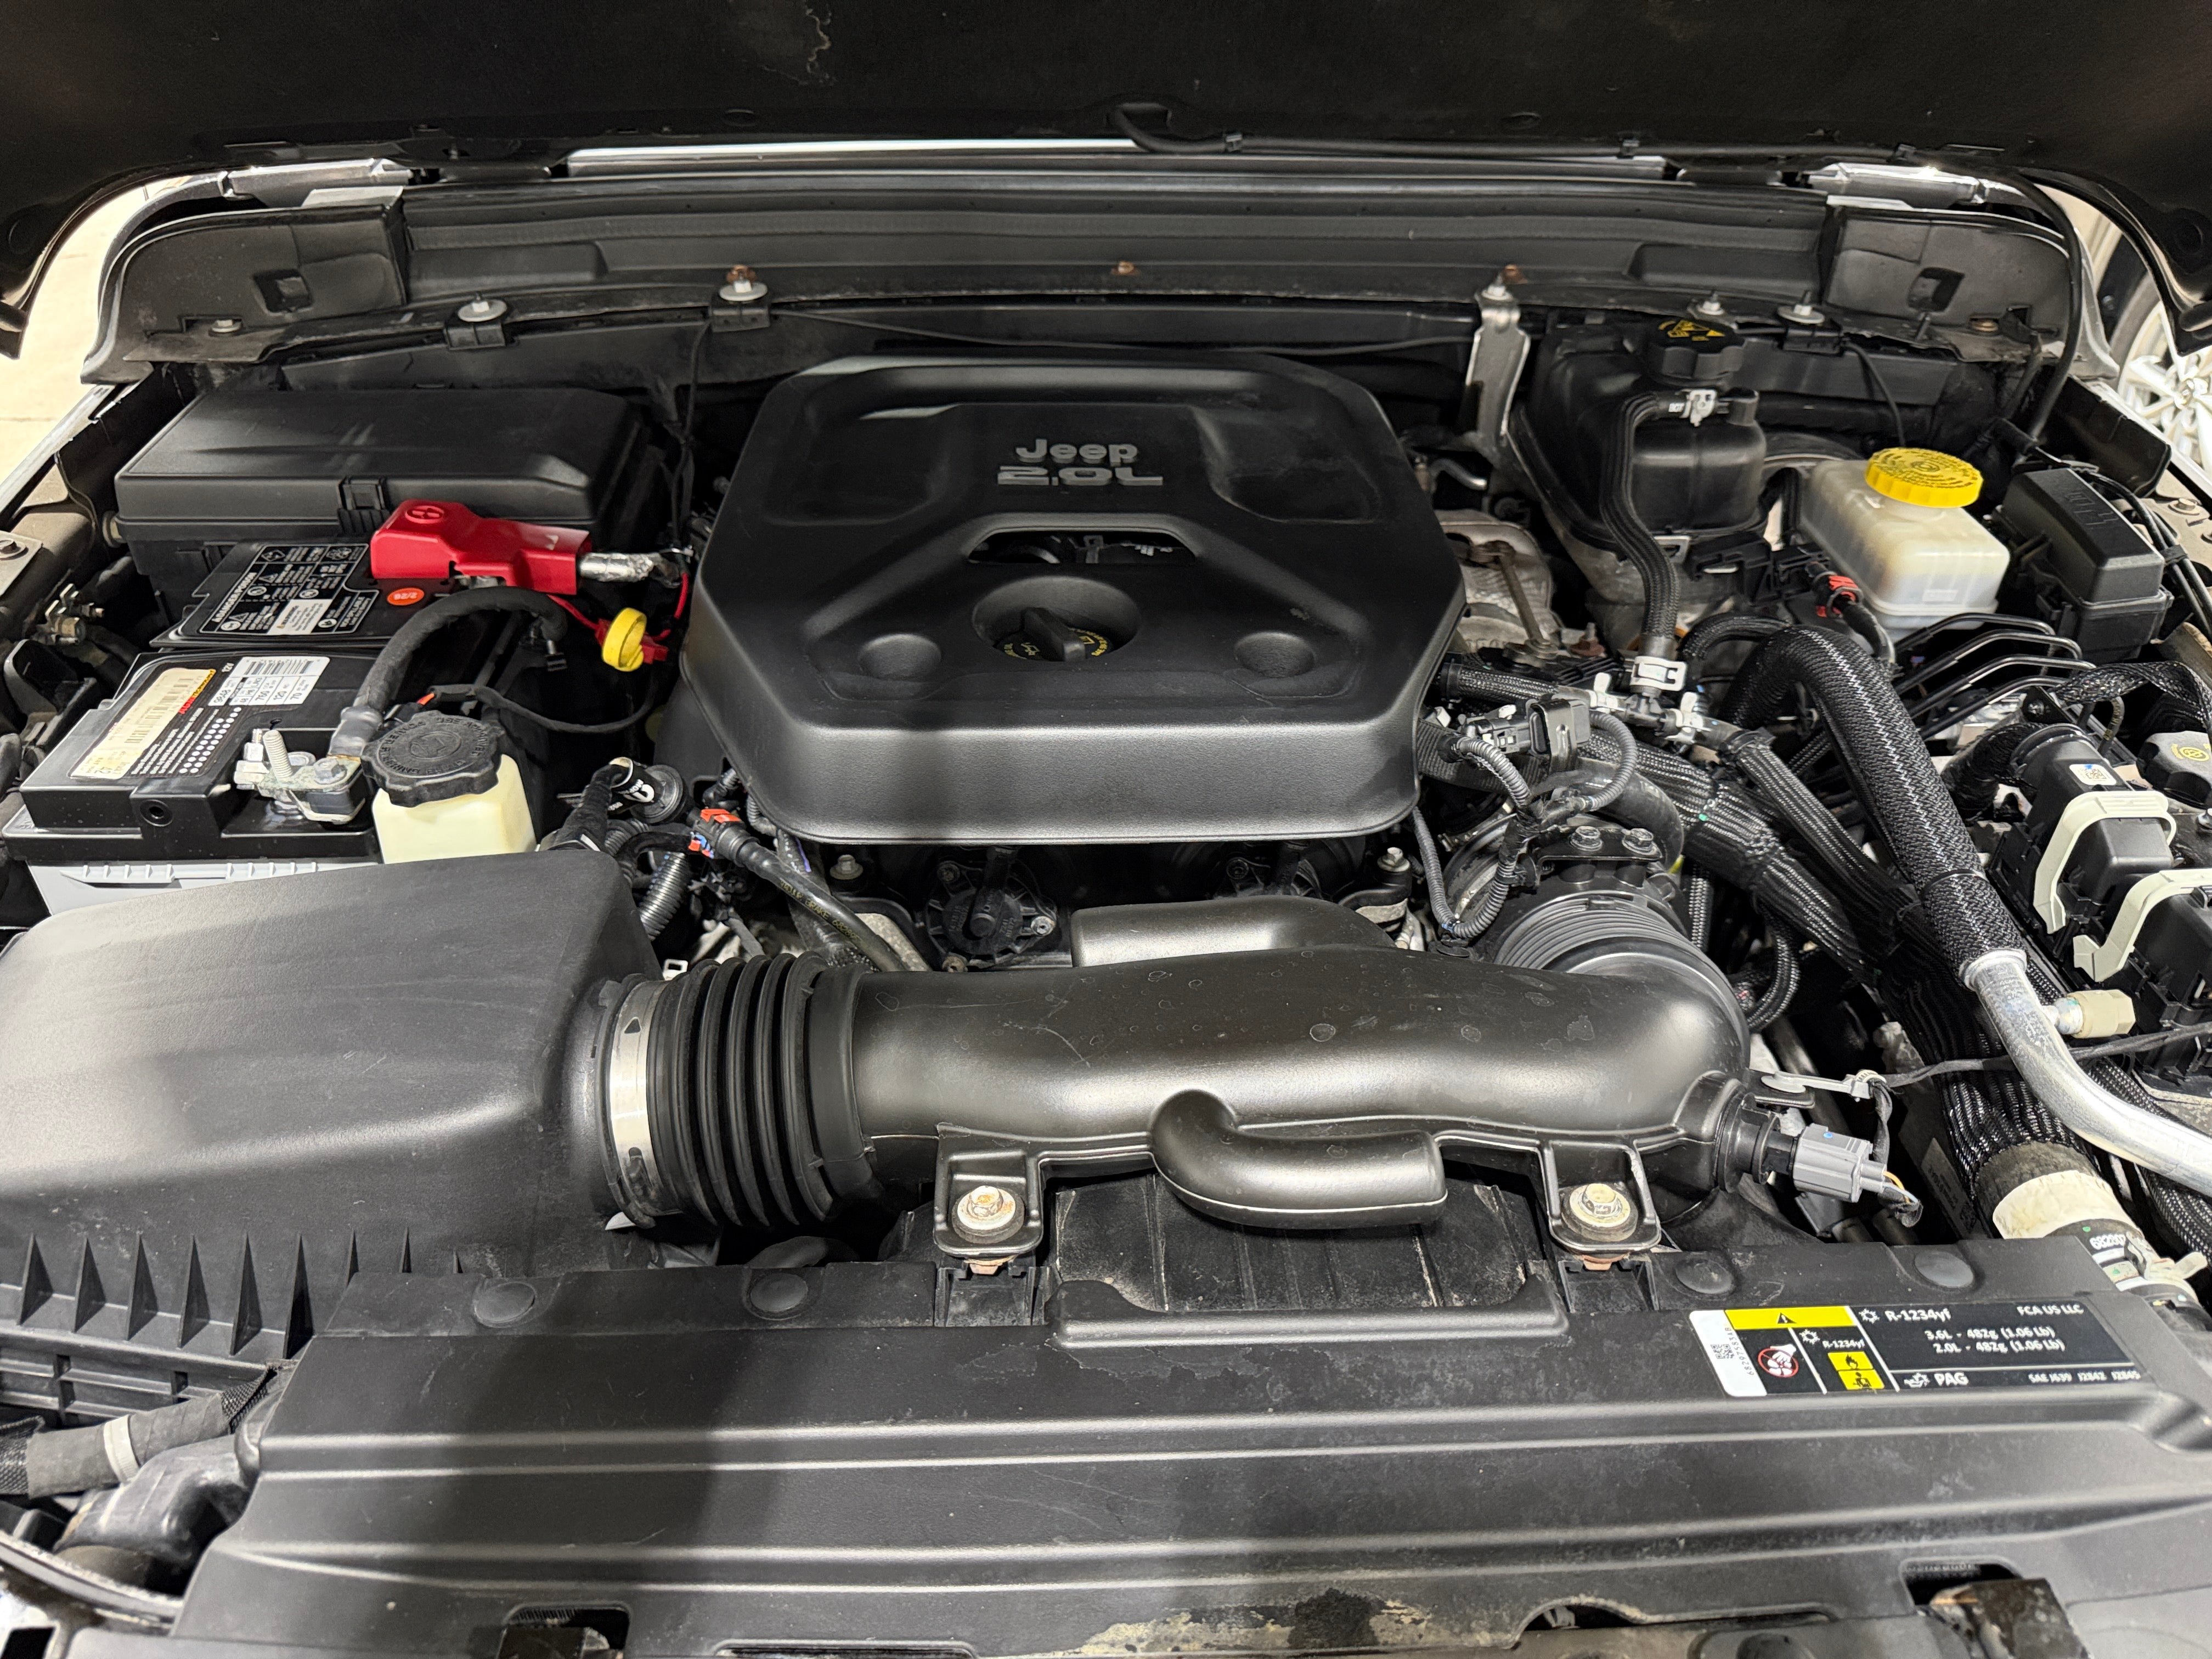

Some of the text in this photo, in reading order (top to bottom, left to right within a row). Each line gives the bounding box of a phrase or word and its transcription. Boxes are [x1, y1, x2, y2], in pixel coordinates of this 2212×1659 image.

[1015, 438, 1138, 467] Jeep
[997, 466, 1164, 486] 2.0L
[805, 898, 831, 919] BRAKE
[1884, 1308, 1951, 1322] R-1234yf
[2016, 1304, 2085, 1316] FCA US LLC
[1924, 1329, 1953, 1341] 3.6L
[1967, 1328, 1999, 1340] 482g
[2000, 1326, 2034, 1340] (1.06
[2033, 1325, 2056, 1339] Lb)
[1822, 1339, 1865, 1349] R-1234yf
[1933, 1342, 1962, 1353] 2.0L
[1976, 1341, 2008, 1354] 482g
[2010, 1339, 2043, 1353] (1.06
[2042, 1339, 2066, 1352] Lb)
[1934, 1372, 1968, 1386] PAG
